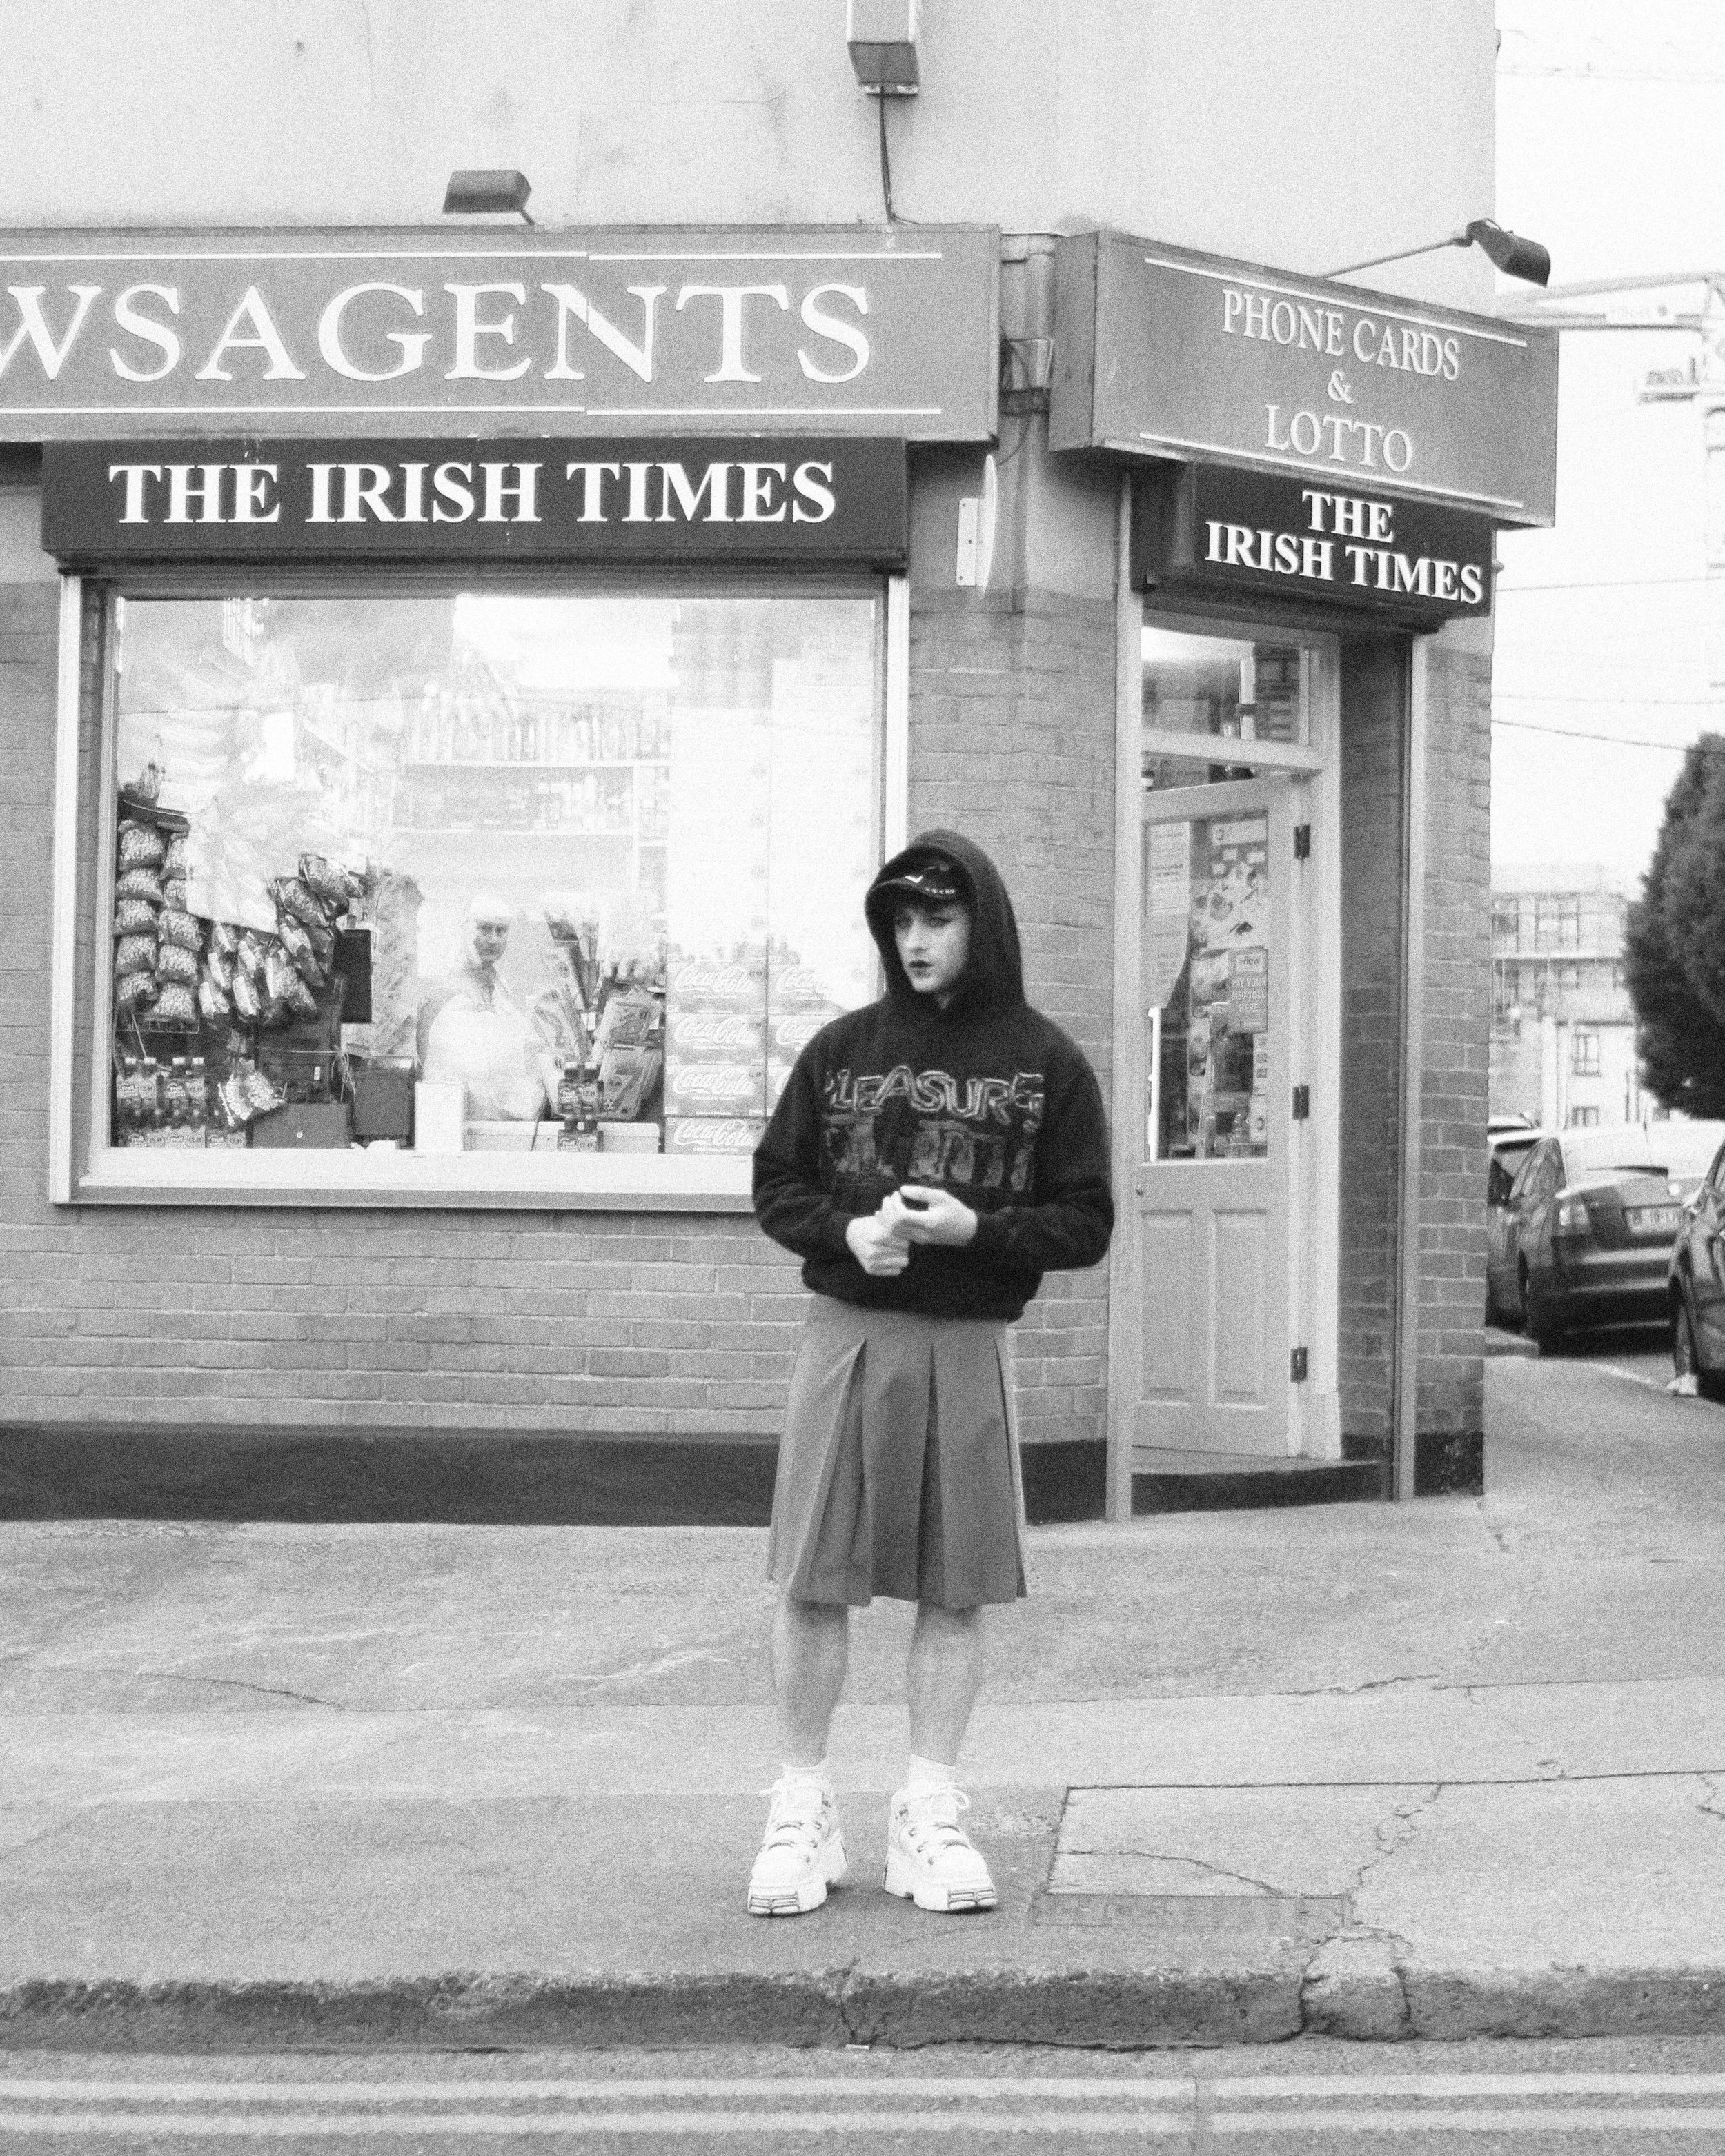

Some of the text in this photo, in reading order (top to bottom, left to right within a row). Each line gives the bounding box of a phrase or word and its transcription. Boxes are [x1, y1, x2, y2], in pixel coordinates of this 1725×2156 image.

[1222, 288, 1461, 381] PHONE CARDS
[1327, 370, 1354, 404] &
[1263, 404, 1414, 473] LOTTO
[108, 460, 836, 524] THE IRISH TIMES
[1301, 490, 1394, 544] THE
[1205, 521, 1484, 604] IRISH TIMES
[1239, 1002, 1259, 1013] HERE
